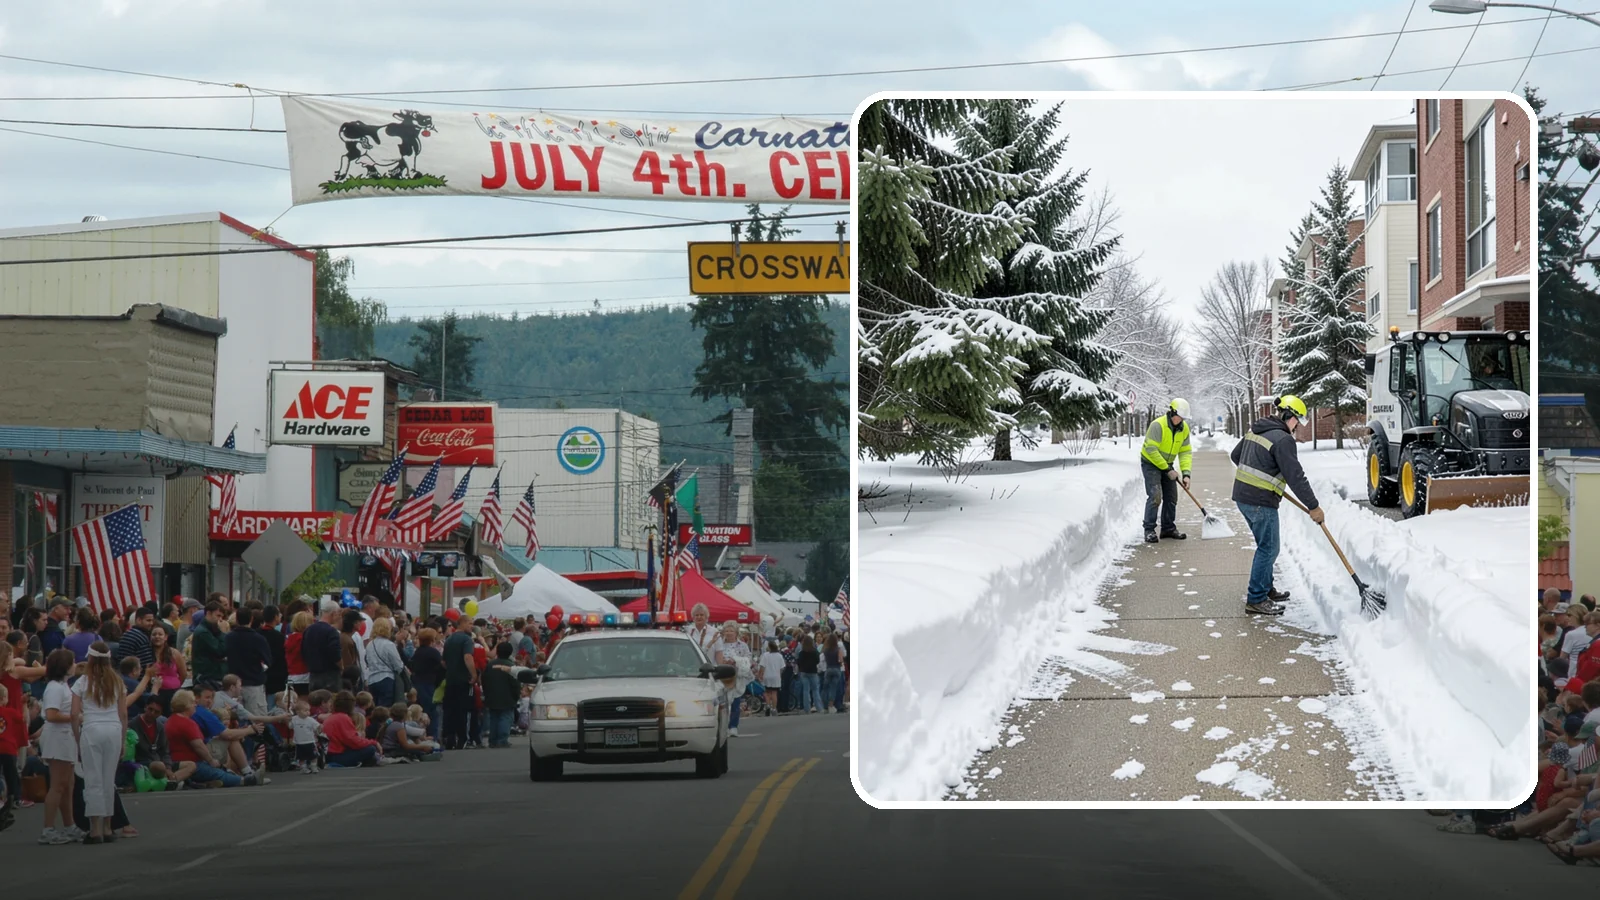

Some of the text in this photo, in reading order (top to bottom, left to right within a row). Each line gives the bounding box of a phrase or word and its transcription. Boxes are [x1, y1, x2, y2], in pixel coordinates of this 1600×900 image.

[481, 140, 605, 193] JULY
[632, 150, 747, 198] 4th.
[697, 254, 850, 280] CROSSWA
[282, 379, 374, 420] ACE
[406, 409, 485, 422] CEDAR LOG
[283, 420, 371, 437] Hardware
[416, 428, 477, 447] Coca-Cola
[95, 484, 124, 495] Vincent
[126, 485, 136, 495] de
[137, 485, 155, 495] Paul
[688, 526, 741, 535] CRNATION
[699, 535, 730, 544] GLASS
